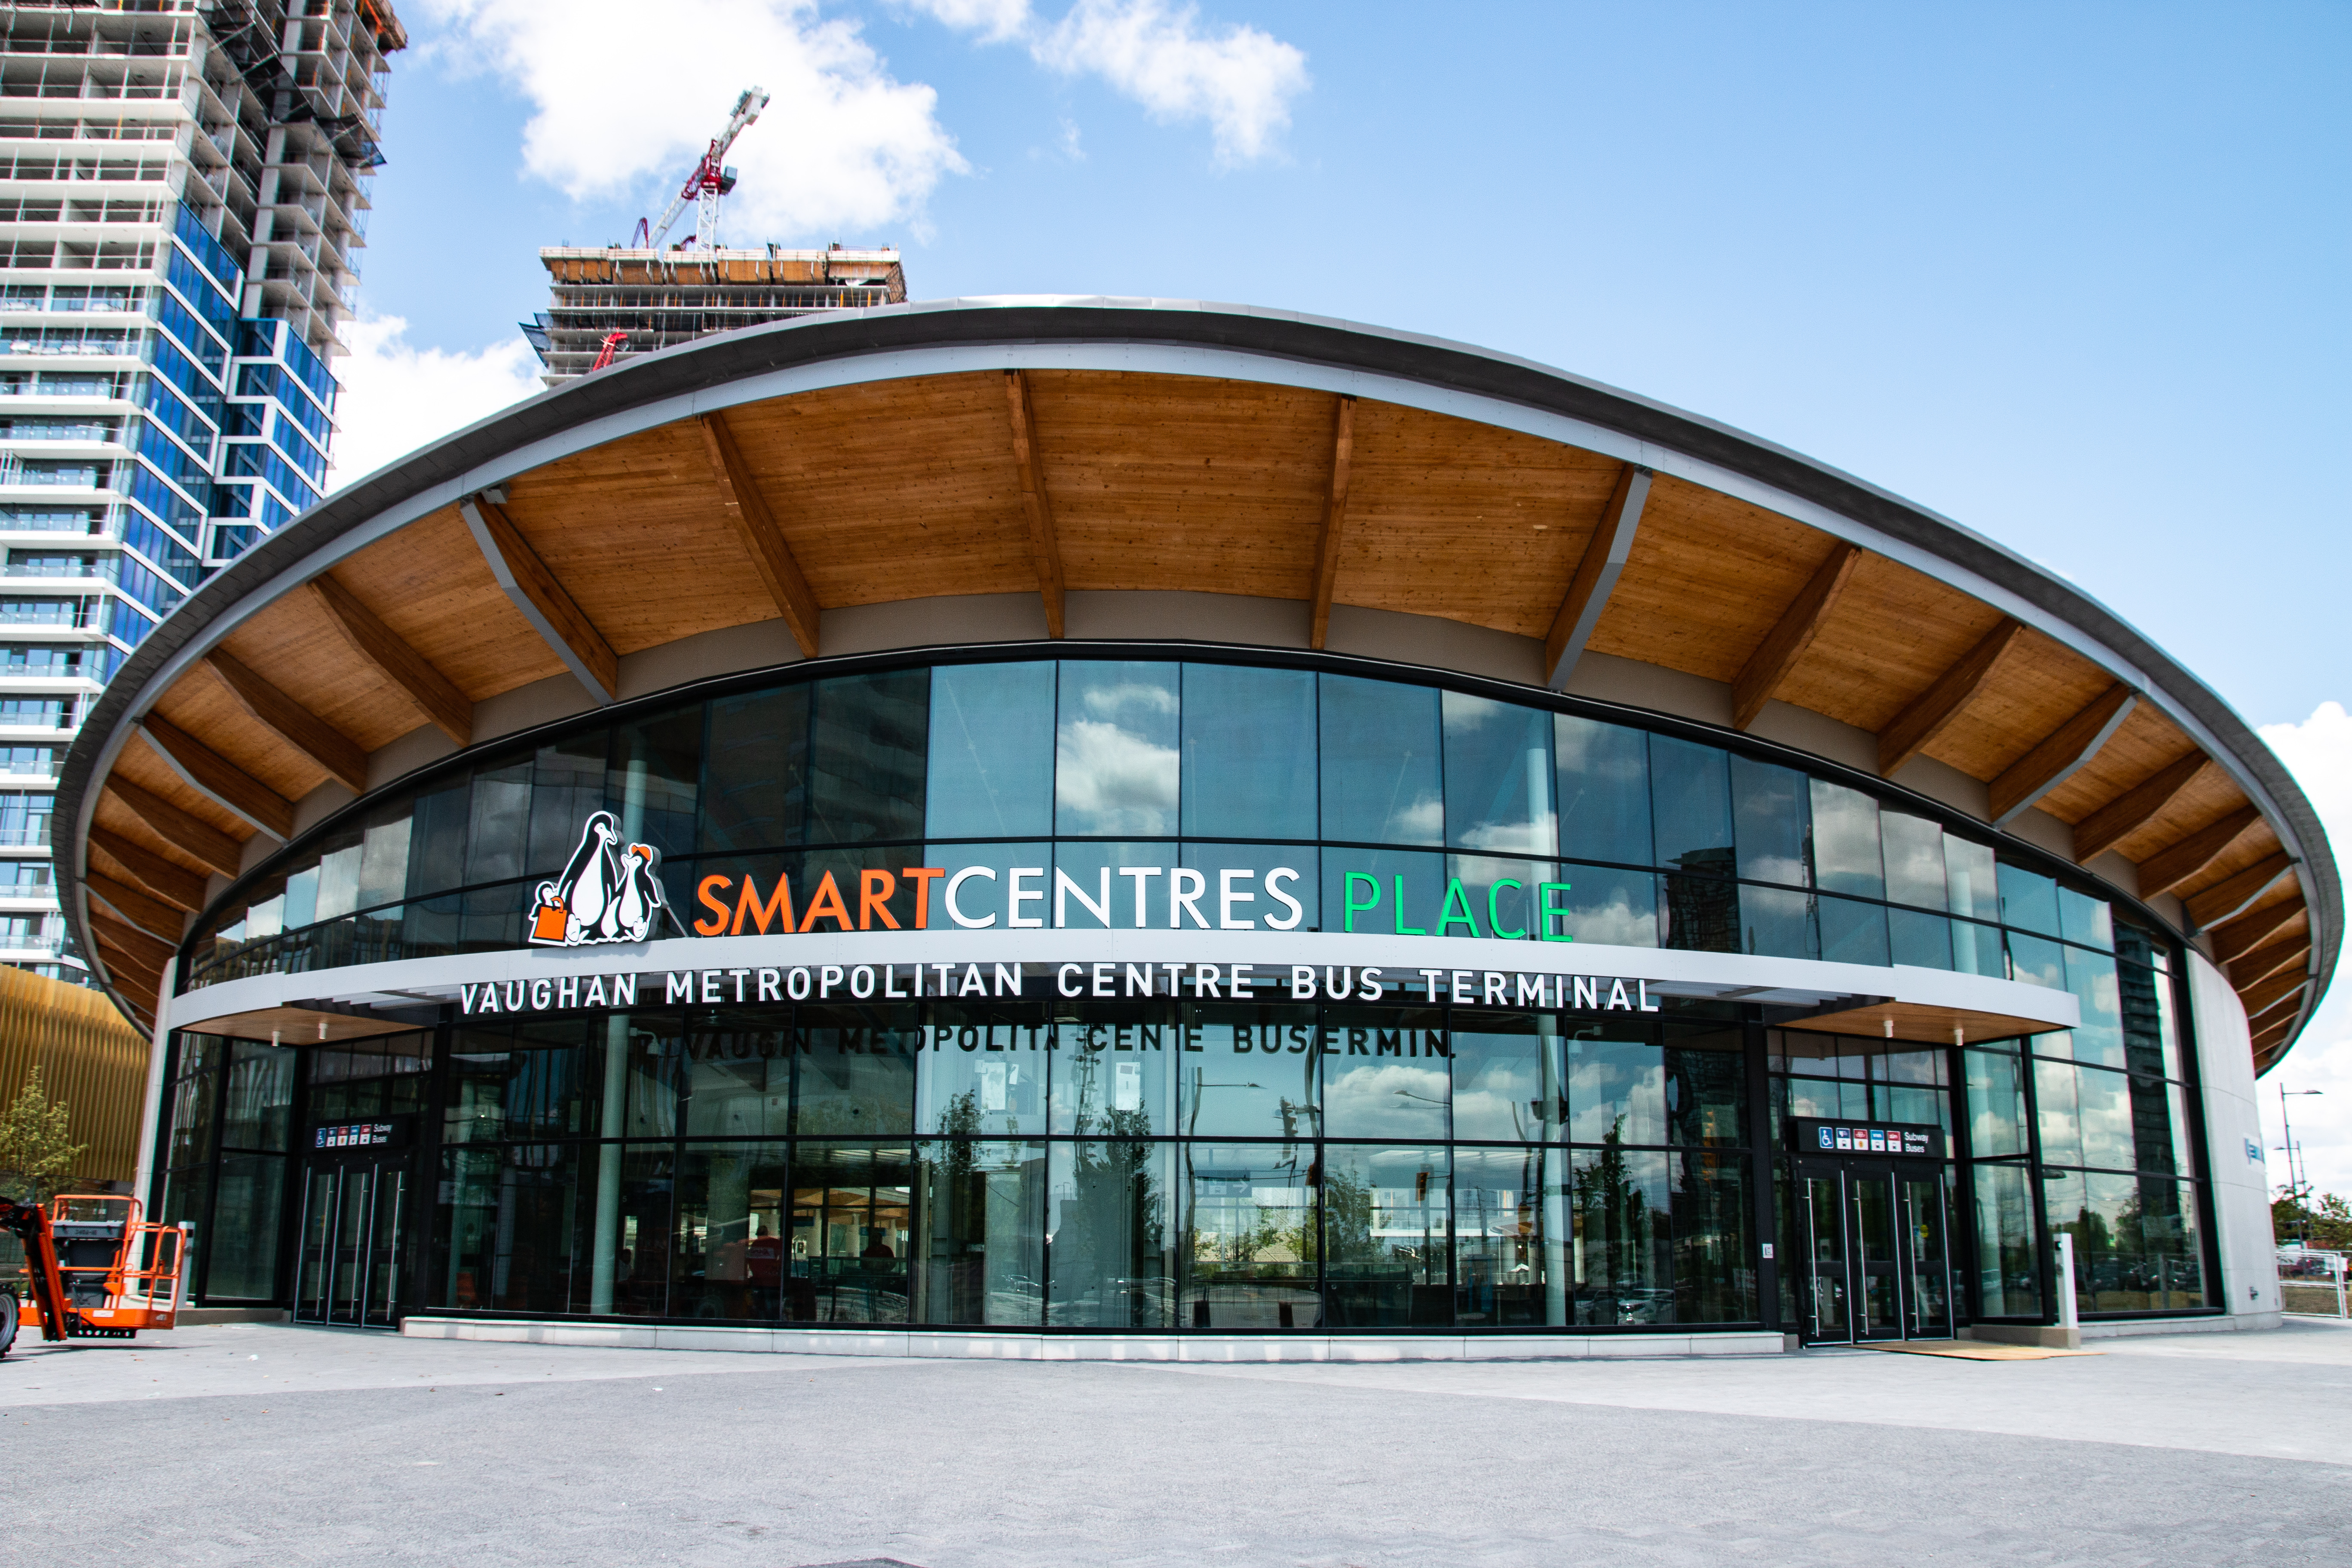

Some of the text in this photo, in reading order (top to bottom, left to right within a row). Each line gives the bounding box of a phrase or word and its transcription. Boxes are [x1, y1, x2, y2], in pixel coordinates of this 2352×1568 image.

[1344, 871, 1574, 942] PLACE
[461, 963, 1659, 1014] VAUGHAN METROPOLITAN CENTRE BUS TERMINAL
[374, 1124, 392, 1133] Subway
[372, 1135, 387, 1143] Buses
[1905, 1132, 1929, 1144] Subway
[1905, 1144, 1925, 1153] Buses
